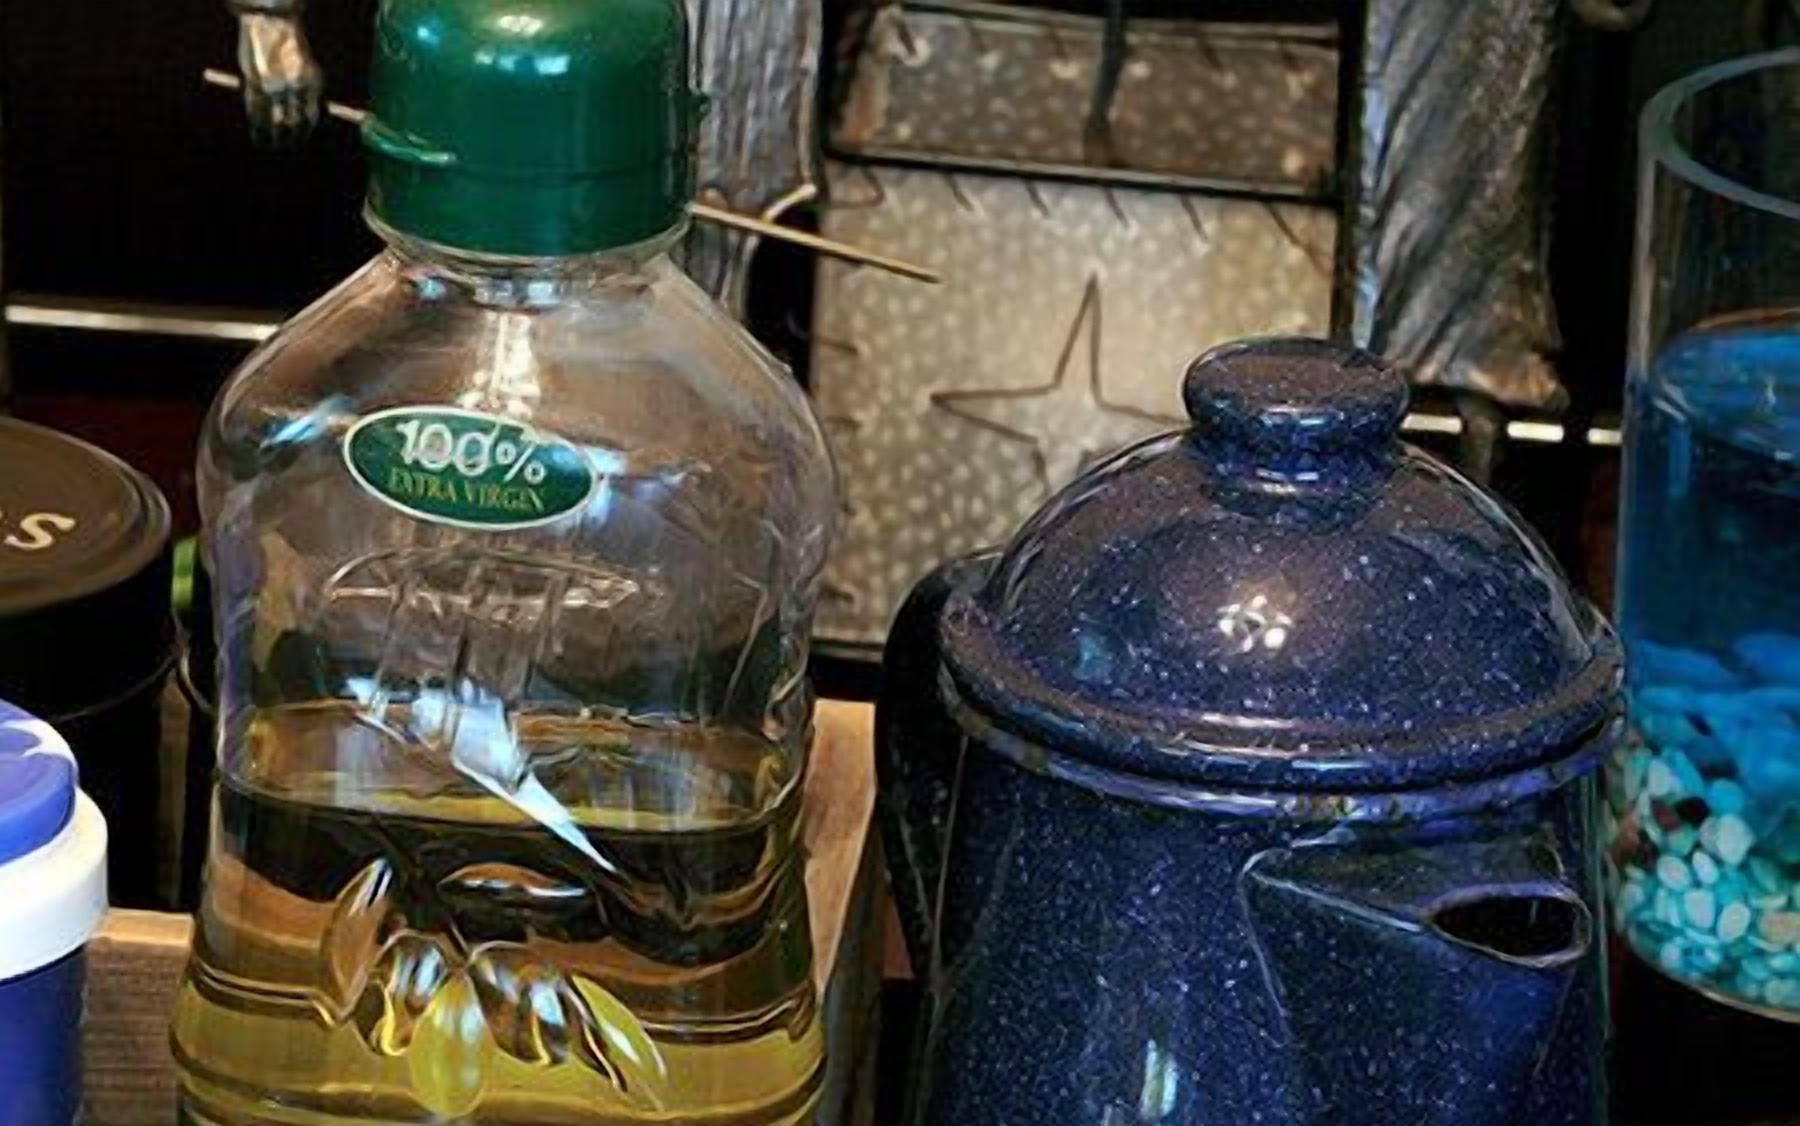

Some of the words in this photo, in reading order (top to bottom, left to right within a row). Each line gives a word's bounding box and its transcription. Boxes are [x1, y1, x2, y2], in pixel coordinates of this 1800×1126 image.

[396, 419, 547, 484] 100%
[389, 467, 456, 502] EXTRA
[464, 480, 545, 513] VIRGIN
